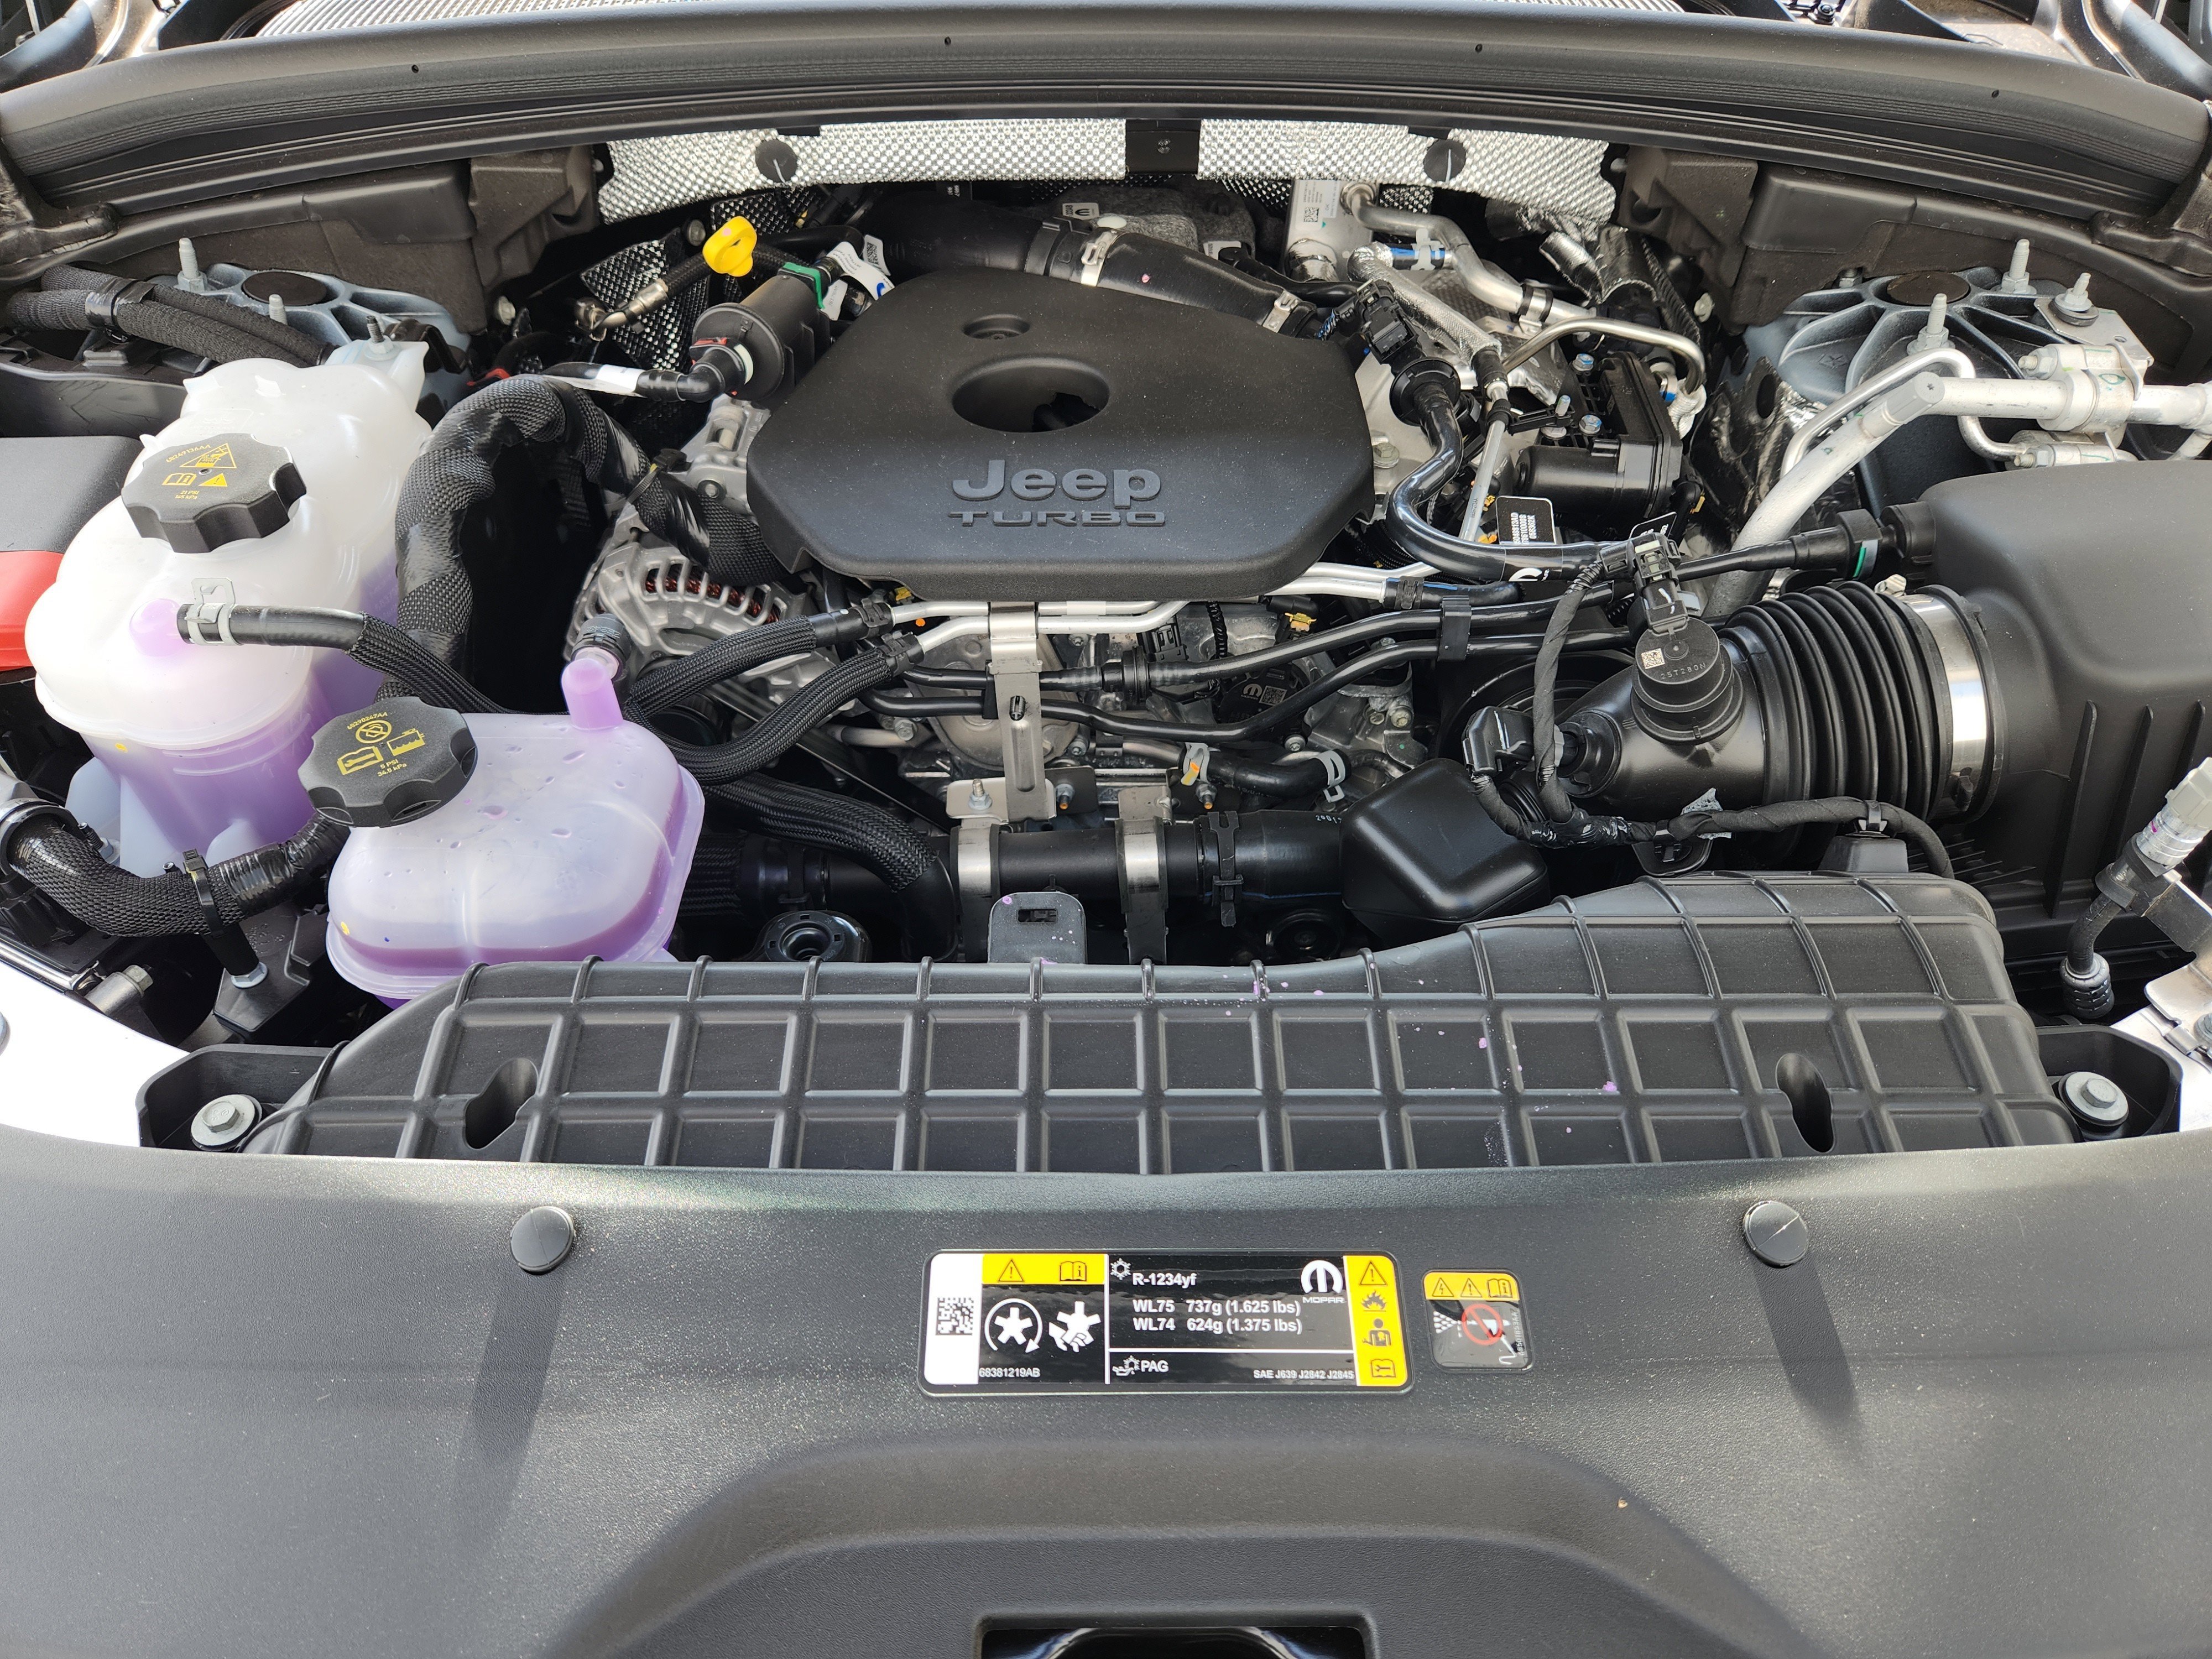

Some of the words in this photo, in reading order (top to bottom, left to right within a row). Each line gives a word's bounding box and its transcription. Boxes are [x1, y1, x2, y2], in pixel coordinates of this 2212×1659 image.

[952, 460, 1161, 509] Jeep
[948, 511, 1166, 526] TURBO
[347, 712, 388, 730] 68290247AA
[377, 768, 393, 777] 34.5
[393, 763, 408, 773] kPa
[387, 759, 399, 768] PSI
[1133, 1272, 1197, 1288] R-1234yf
[1133, 1299, 1175, 1312] WL75
[1186, 1300, 1222, 1316] 737g
[1225, 1300, 1270, 1316] (1.625
[1272, 1300, 1301, 1317] lbs)
[1133, 1317, 1176, 1331] WL74
[1187, 1318, 1223, 1334] 624g
[1226, 1318, 1271, 1334] (1.375
[1274, 1318, 1303, 1335] lbs)
[979, 1368, 1040, 1378] 68381219AB
[1141, 1360, 1169, 1373] PAG
[1253, 1369, 1274, 1379] SAE
[1275, 1369, 1297, 1379] J639
[1298, 1370, 1326, 1379] J2842
[1327, 1370, 1355, 1379] J2845
